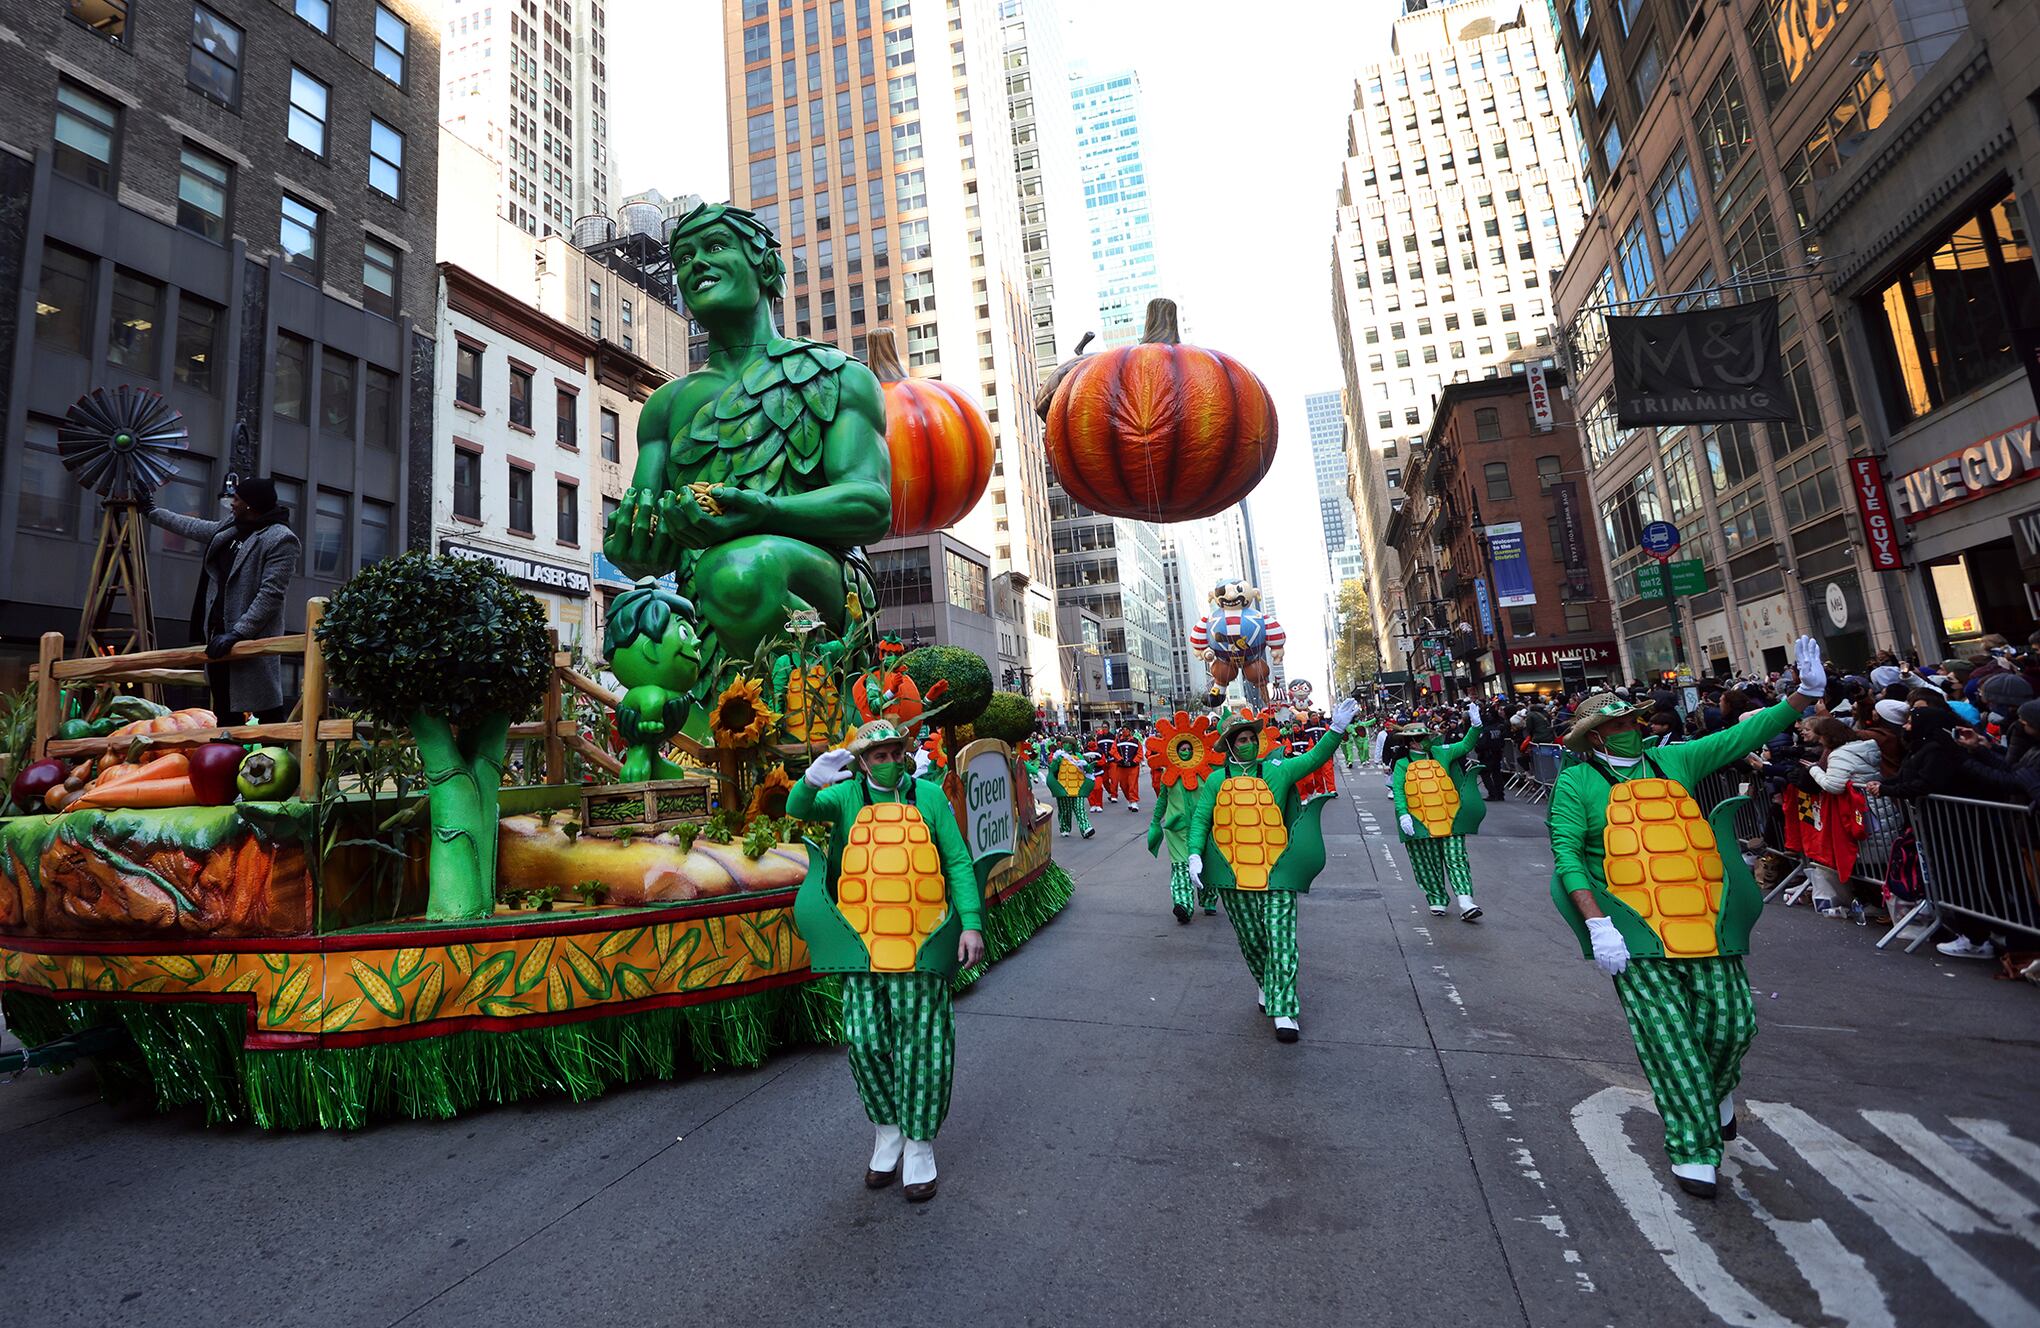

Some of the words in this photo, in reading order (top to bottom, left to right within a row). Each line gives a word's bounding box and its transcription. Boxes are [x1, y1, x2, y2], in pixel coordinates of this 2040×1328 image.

[1631, 313, 1766, 390] M&J
[1530, 375, 1547, 409] PARK
[1630, 393, 1769, 414] TRIMMING
[1960, 420, 2040, 491] GUY
[1561, 489, 1569, 505] LOVE
[1857, 461, 1881, 511] FIVE
[1869, 515, 1895, 565] GUYS
[1567, 529, 1575, 542] YOU
[1570, 543, 1579, 562] LEASE
[525, 563, 567, 588] LASER
[567, 572, 590, 592] SPA
[1638, 566, 1659, 576] QM10
[1640, 577, 1661, 588] QM12
[1642, 588, 1664, 599] QM24
[1513, 651, 1537, 667] PRET
[1541, 652, 1549, 665] A
[968, 772, 1006, 812] Green
[976, 811, 1009, 853] Giant
